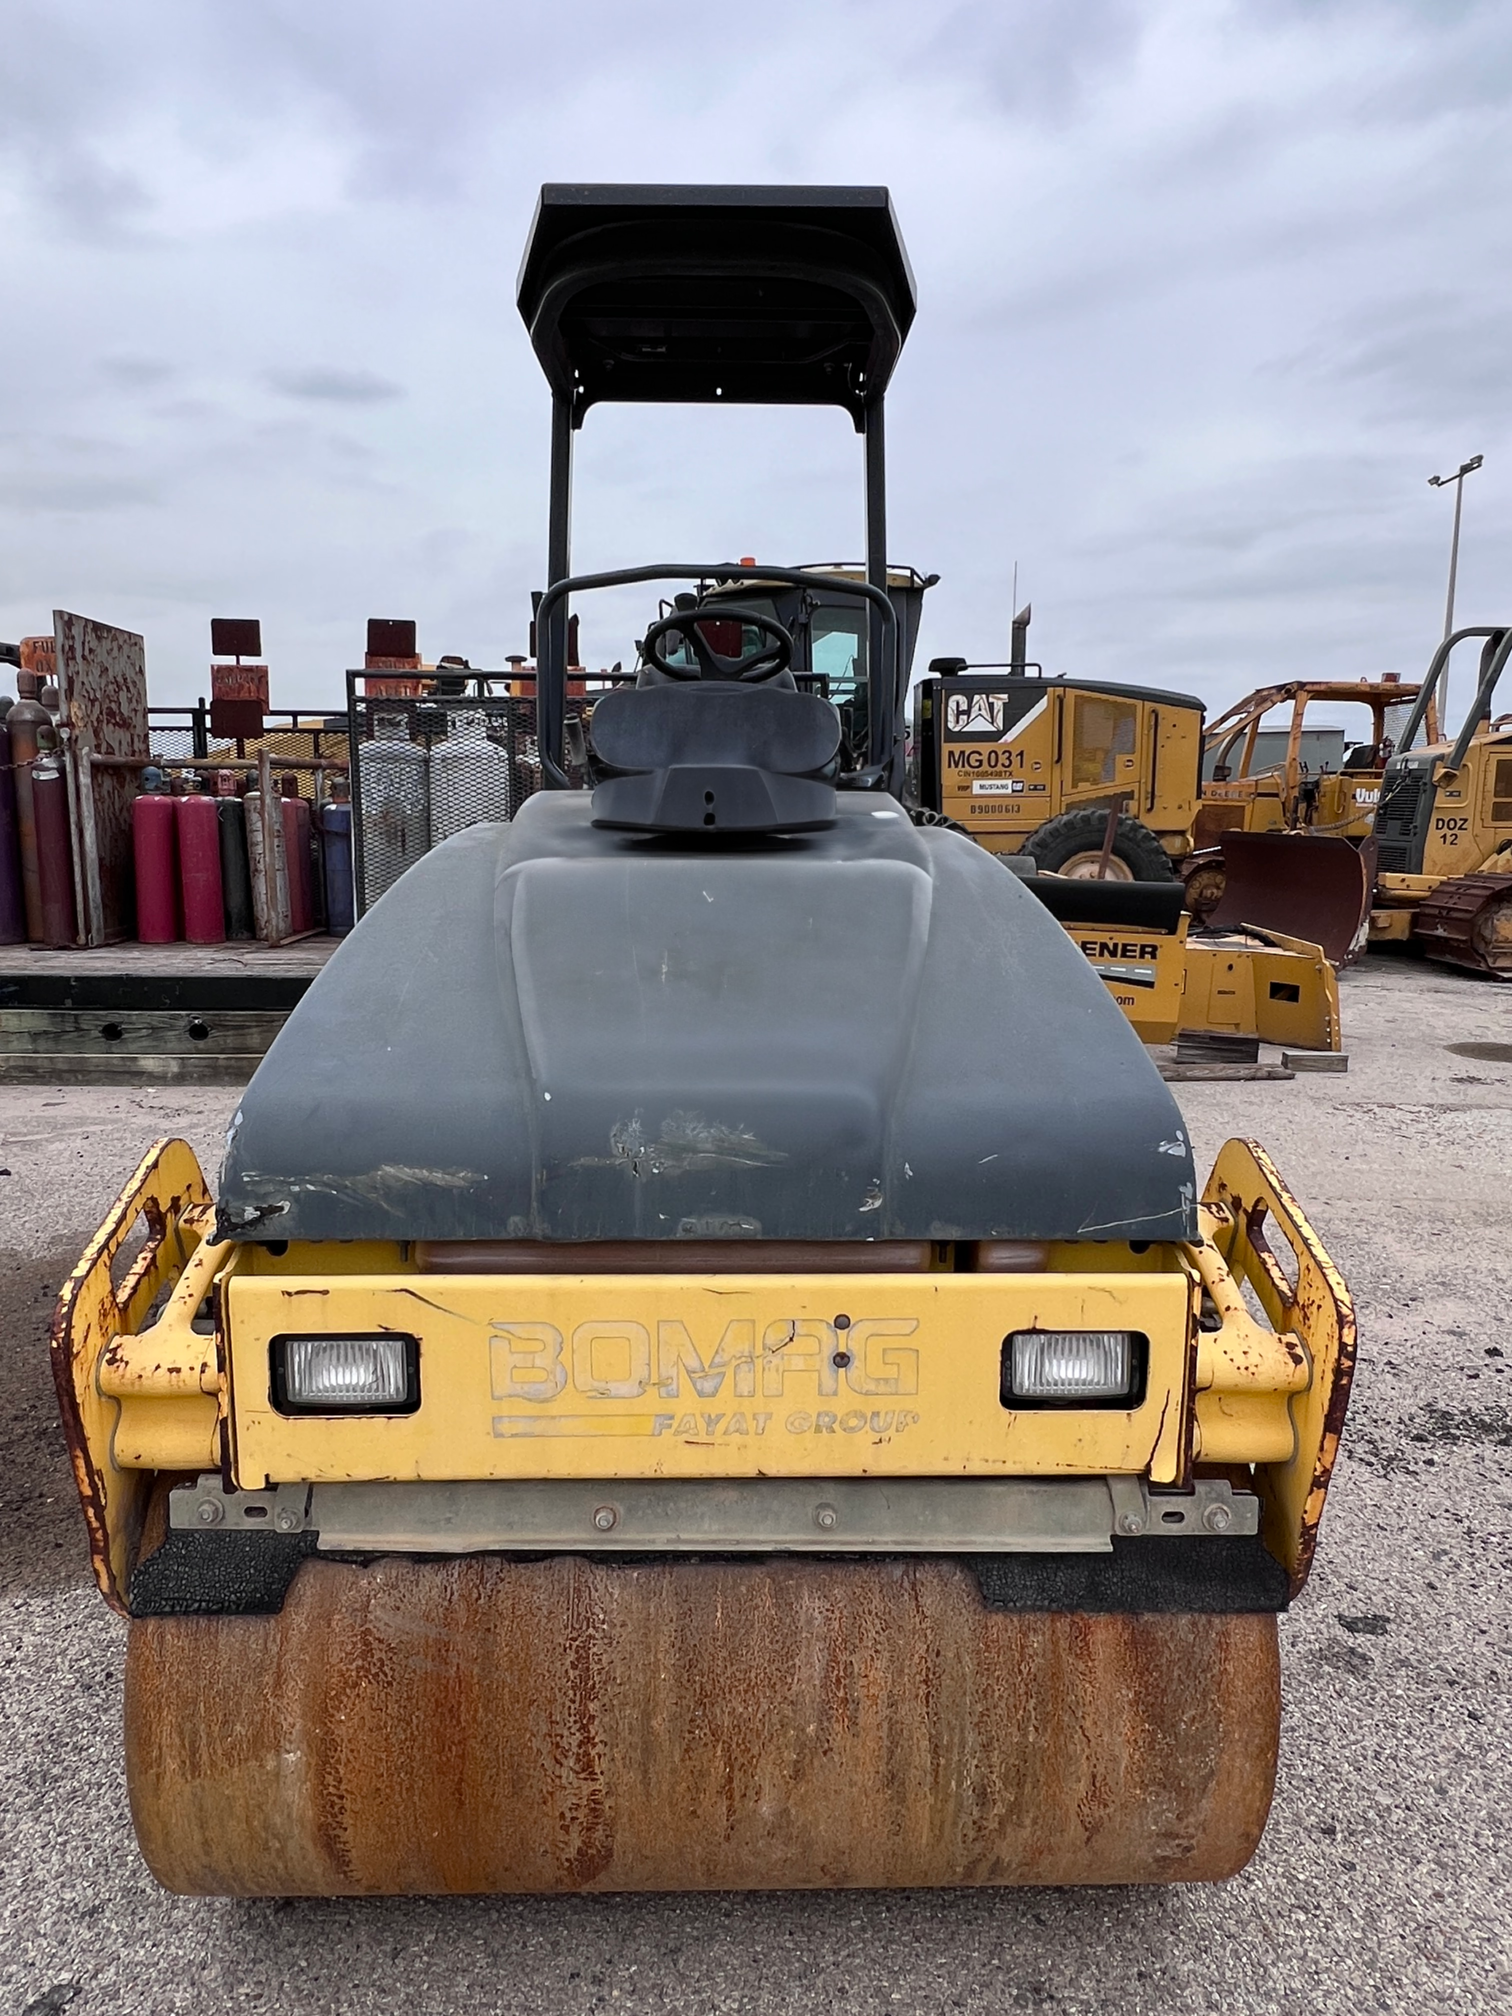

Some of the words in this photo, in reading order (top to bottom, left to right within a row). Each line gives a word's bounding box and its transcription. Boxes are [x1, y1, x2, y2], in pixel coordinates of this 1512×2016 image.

[33, 641, 56, 654] FUL
[947, 694, 1009, 732] CAT
[979, 783, 1009, 791] MUSTANG
[1435, 818, 1469, 831] DOZ
[1440, 834, 1458, 845] 12
[1076, 940, 1159, 960] ENER
[489, 1318, 920, 1402] BOMAG
[652, 1411, 773, 1437] FAYAT
[784, 1409, 920, 1435] GROUP
